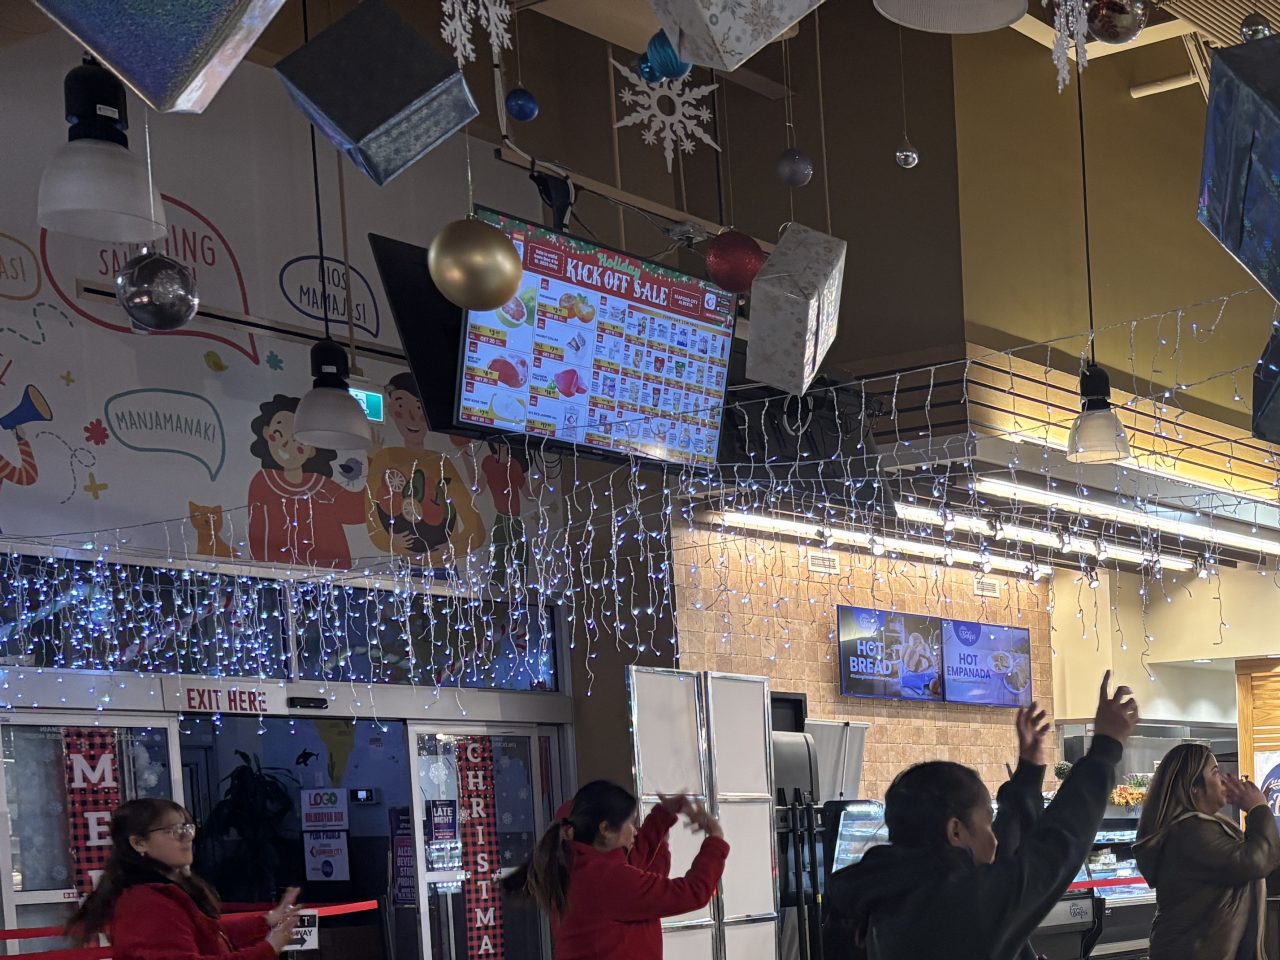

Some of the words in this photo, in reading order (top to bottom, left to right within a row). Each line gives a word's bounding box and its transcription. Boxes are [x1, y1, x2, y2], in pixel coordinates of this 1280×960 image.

[597, 252, 640, 281] Holiday
[566, 258, 604, 287] KICK
[604, 270, 630, 294] OFF
[633, 280, 669, 306] SALE
[299, 284, 367, 324] MAMAJSI
[115, 410, 216, 443] MANJAMANAKI
[857, 639, 885, 657] HOT
[850, 657, 892, 676] BREAD
[959, 653, 979, 667] HOT
[947, 665, 992, 681] EMPANADA
[186, 688, 222, 710] EXIT
[227, 690, 268, 713] HERE
[309, 791, 338, 806] LOGO
[433, 807, 453, 817] LATE
[434, 816, 453, 824] NIGHT
